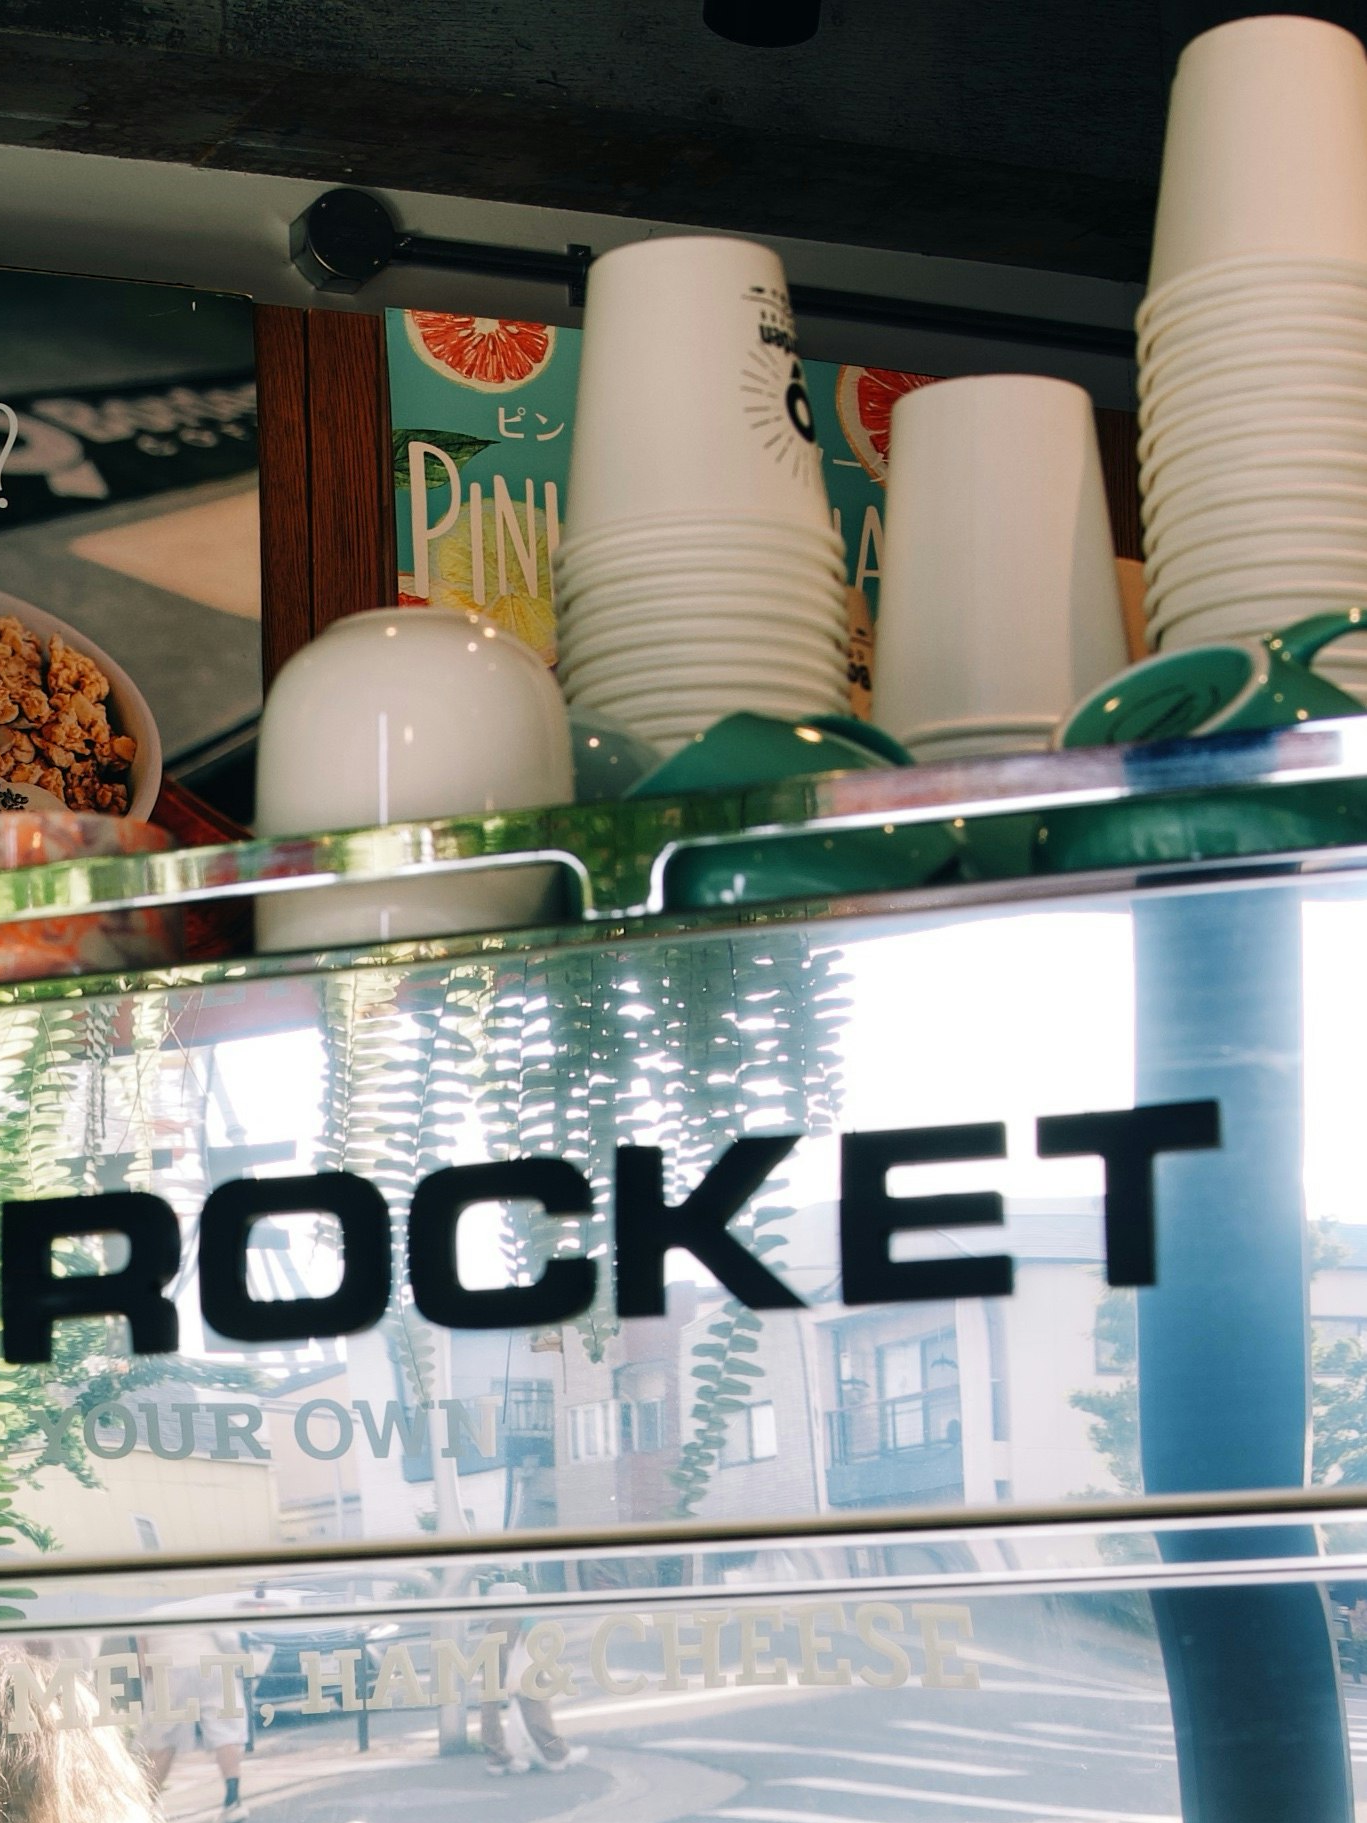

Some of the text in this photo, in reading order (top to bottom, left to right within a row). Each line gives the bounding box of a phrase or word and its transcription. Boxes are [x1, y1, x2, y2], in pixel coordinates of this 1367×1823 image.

[0, 1098, 1223, 1365] ROCKET
[29, 1401, 272, 1461] YOUR
[293, 1396, 502, 1461] OWN
[7, 1652, 276, 1736] MELT,
